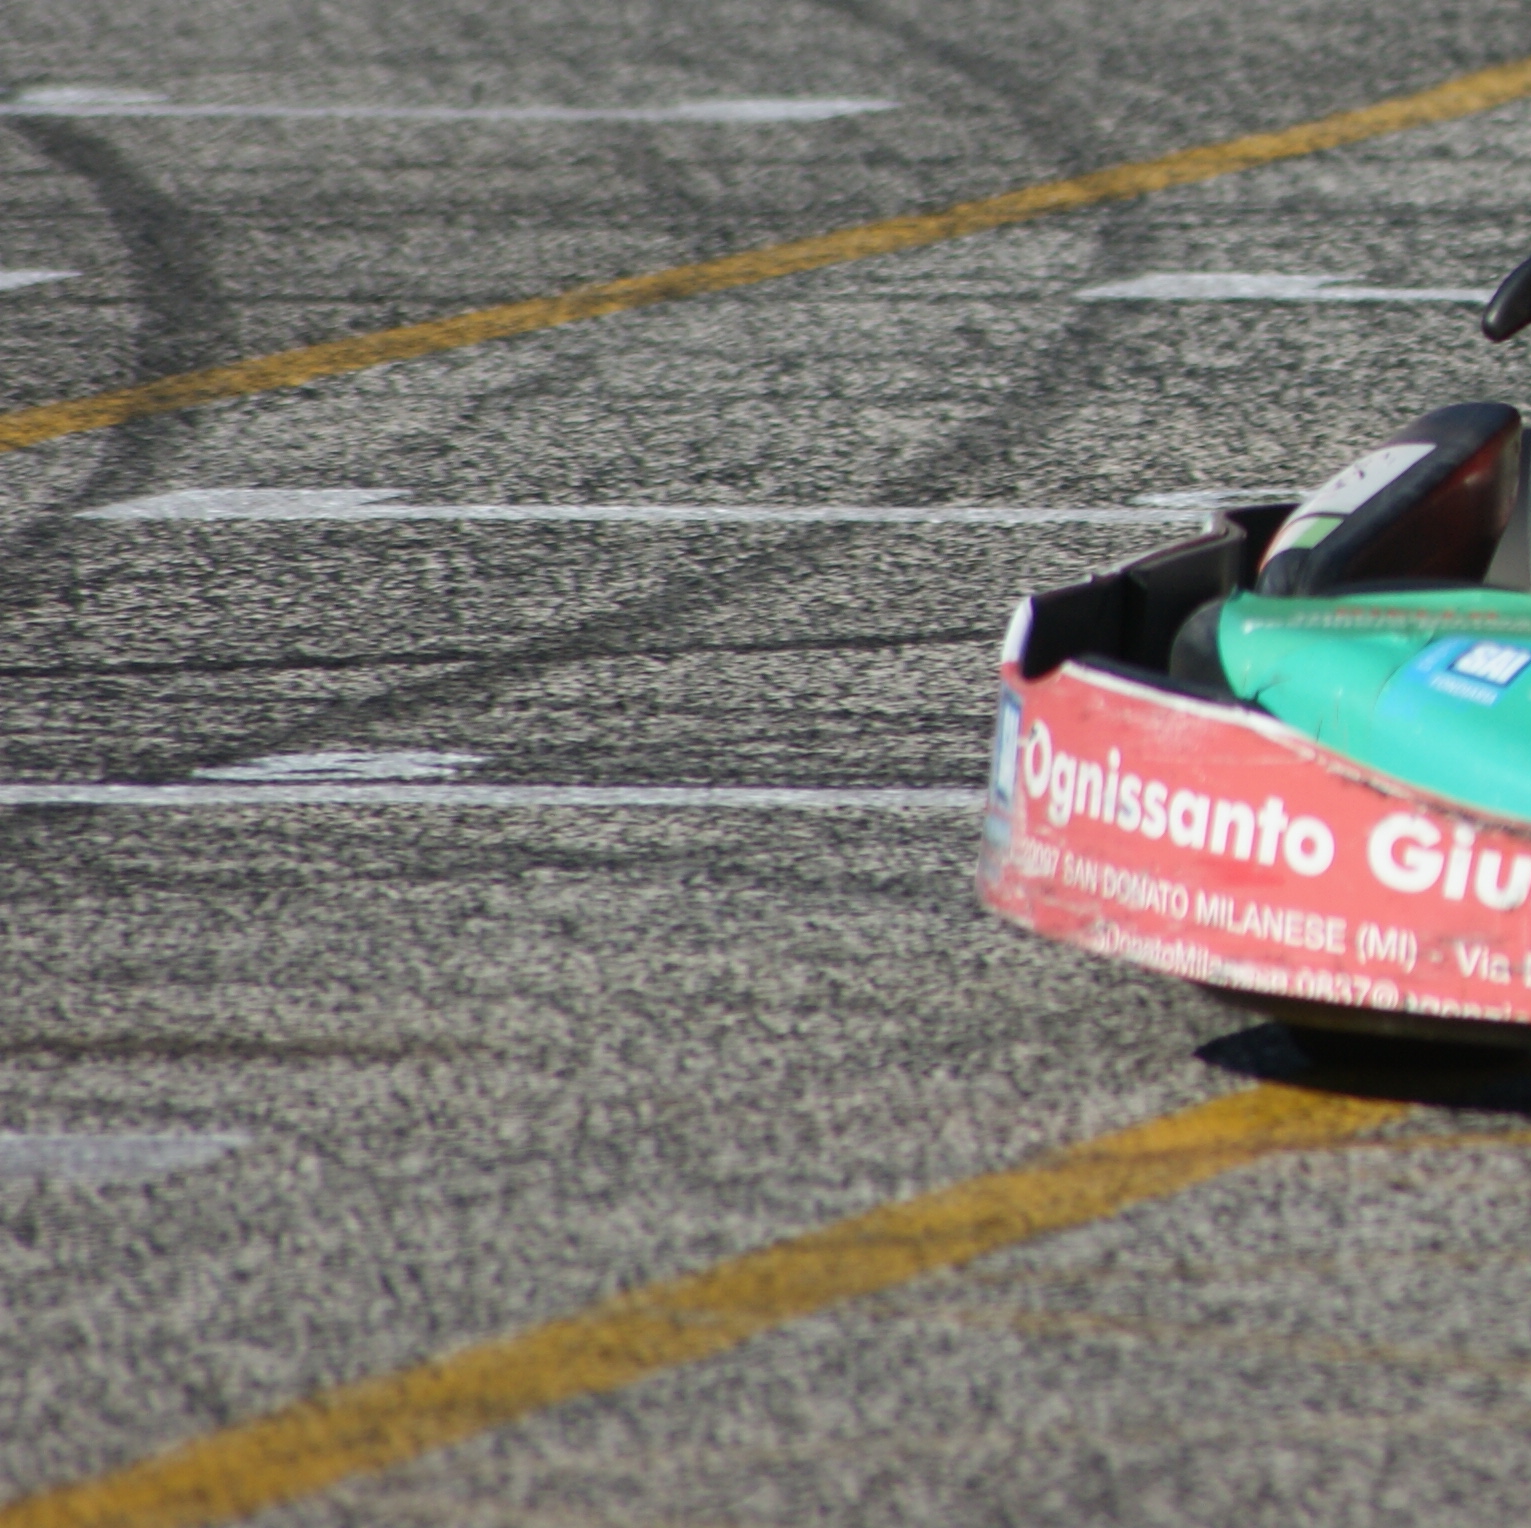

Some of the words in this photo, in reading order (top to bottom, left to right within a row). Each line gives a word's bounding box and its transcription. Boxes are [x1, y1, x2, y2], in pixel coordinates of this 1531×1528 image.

[1022, 720, 1336, 876] Ognissanto
[1063, 853, 1099, 894] SAN
[1101, 865, 1189, 920] DONATO
[1195, 890, 1347, 955] MILANESE
[1355, 921, 1419, 974] (MI)
[1456, 941, 1513, 985] Via
